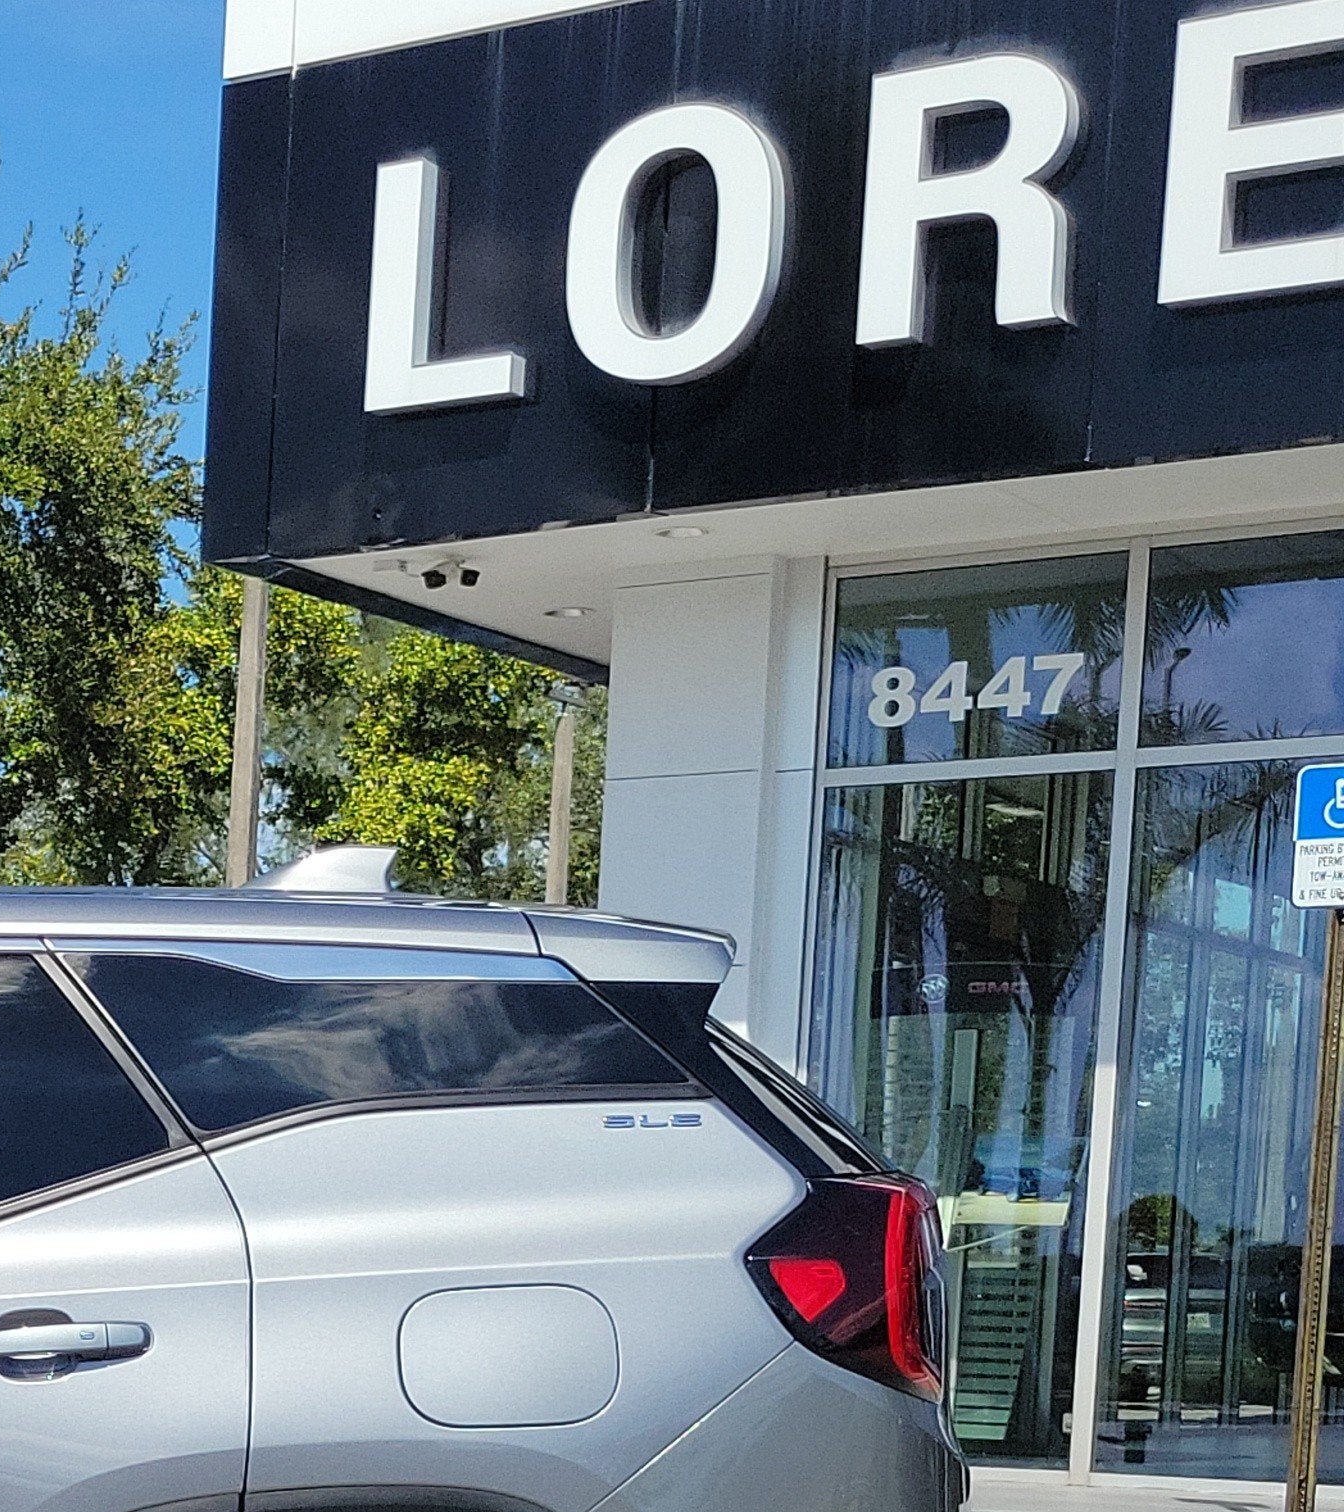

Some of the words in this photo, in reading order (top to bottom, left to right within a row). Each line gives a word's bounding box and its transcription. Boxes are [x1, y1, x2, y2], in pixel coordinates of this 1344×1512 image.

[364, 1, 1344, 413] LORE
[868, 652, 1085, 727] 8447
[602, 1113, 703, 1129] SLE
